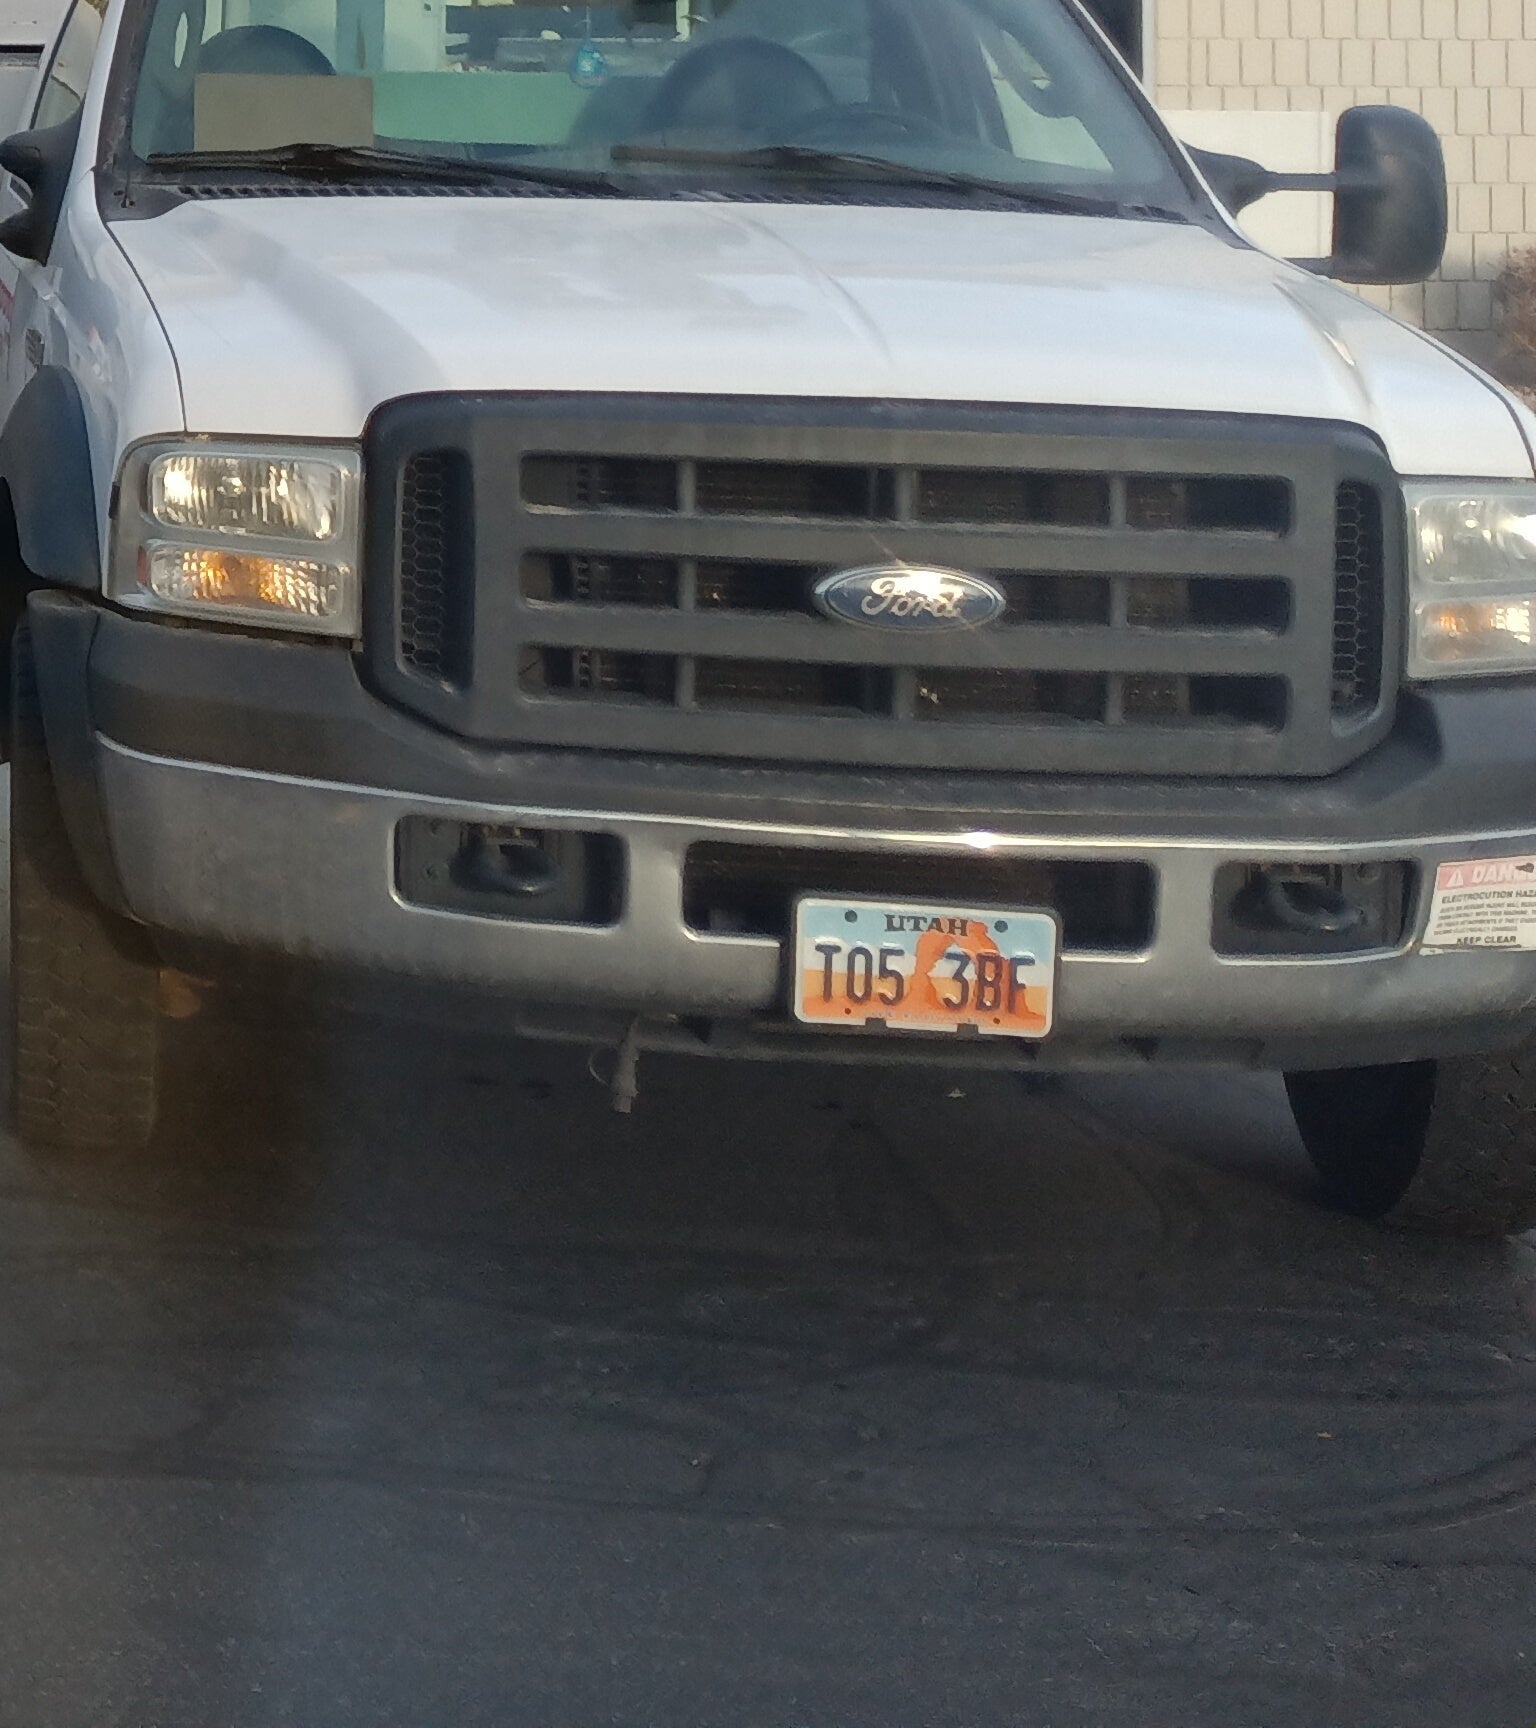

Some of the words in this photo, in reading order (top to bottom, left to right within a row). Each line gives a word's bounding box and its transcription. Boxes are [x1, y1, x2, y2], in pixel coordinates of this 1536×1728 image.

[860, 575, 965, 618] Ford
[884, 913, 969, 937] UTAH
[1484, 935, 1517, 944] CLEAR
[942, 950, 1036, 1015] 3BF
